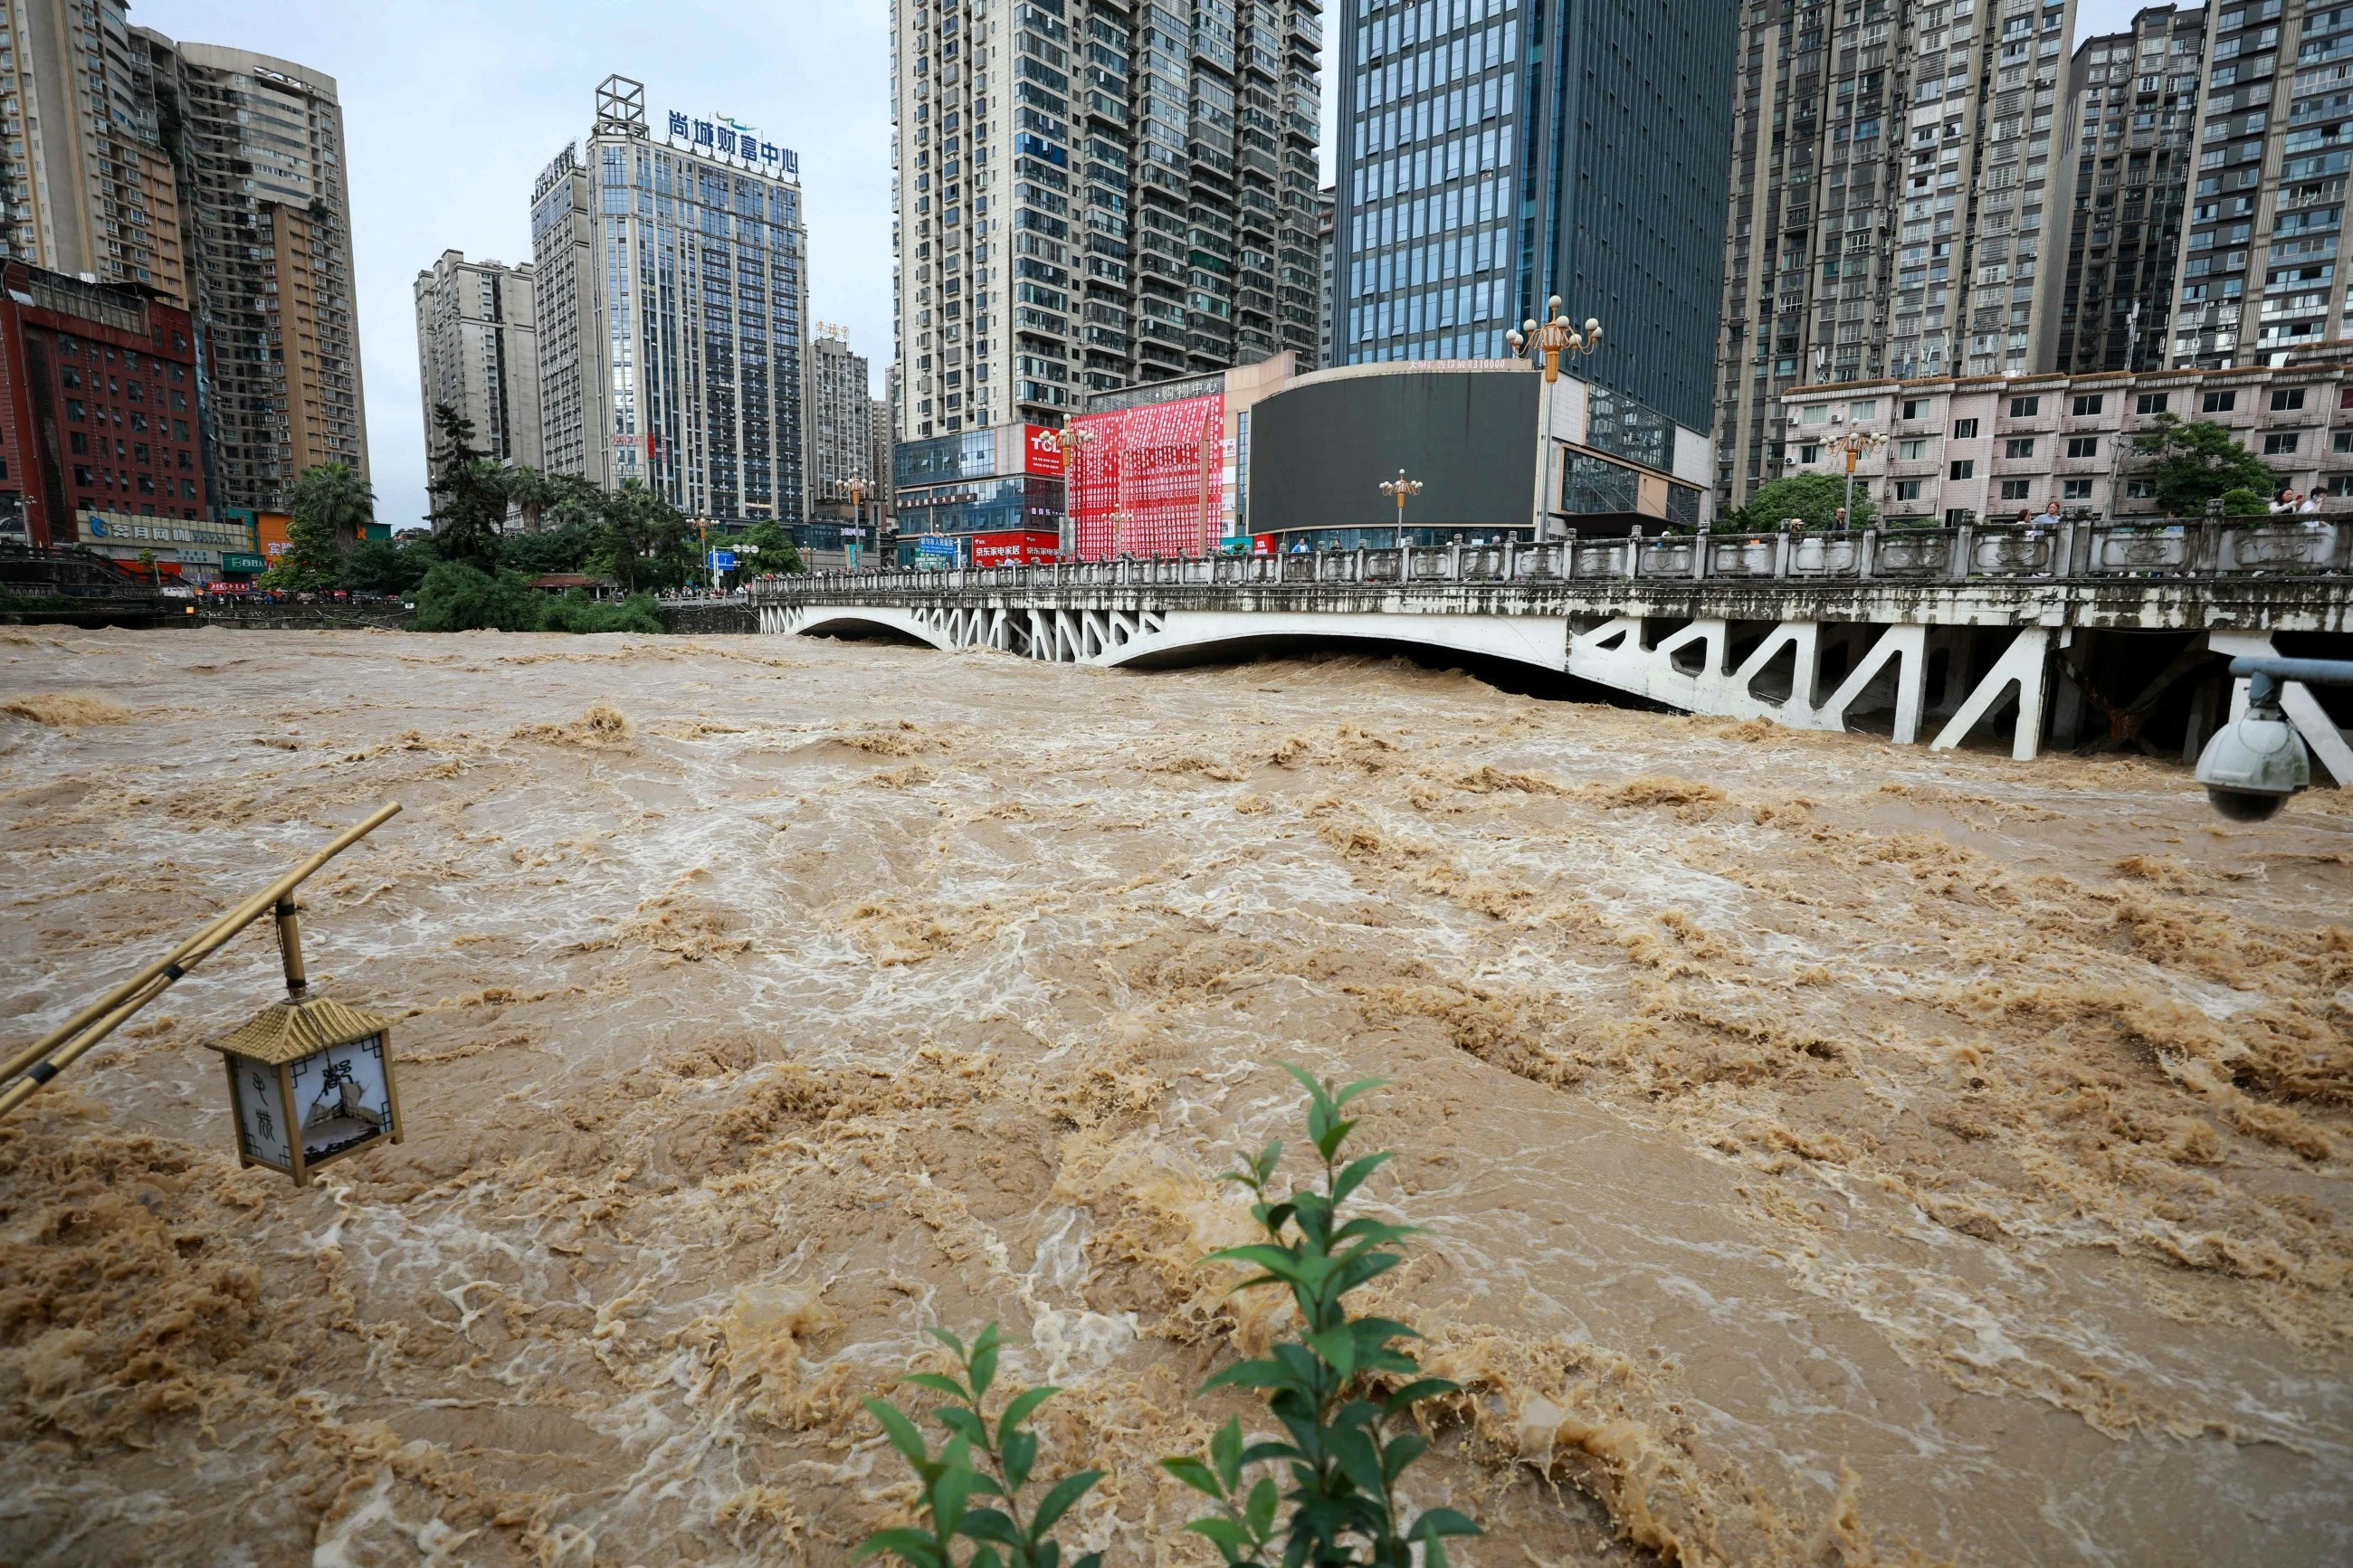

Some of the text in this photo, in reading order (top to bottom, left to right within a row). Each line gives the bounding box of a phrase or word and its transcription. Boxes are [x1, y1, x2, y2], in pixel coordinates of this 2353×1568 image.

[669, 109, 799, 174] 尚城财富中心
[1161, 379, 1217, 402] 购物中心
[1031, 437, 1061, 454] TCL
[111, 523, 191, 542] 奔月网咖
[976, 545, 1020, 556] 京东家电家居
